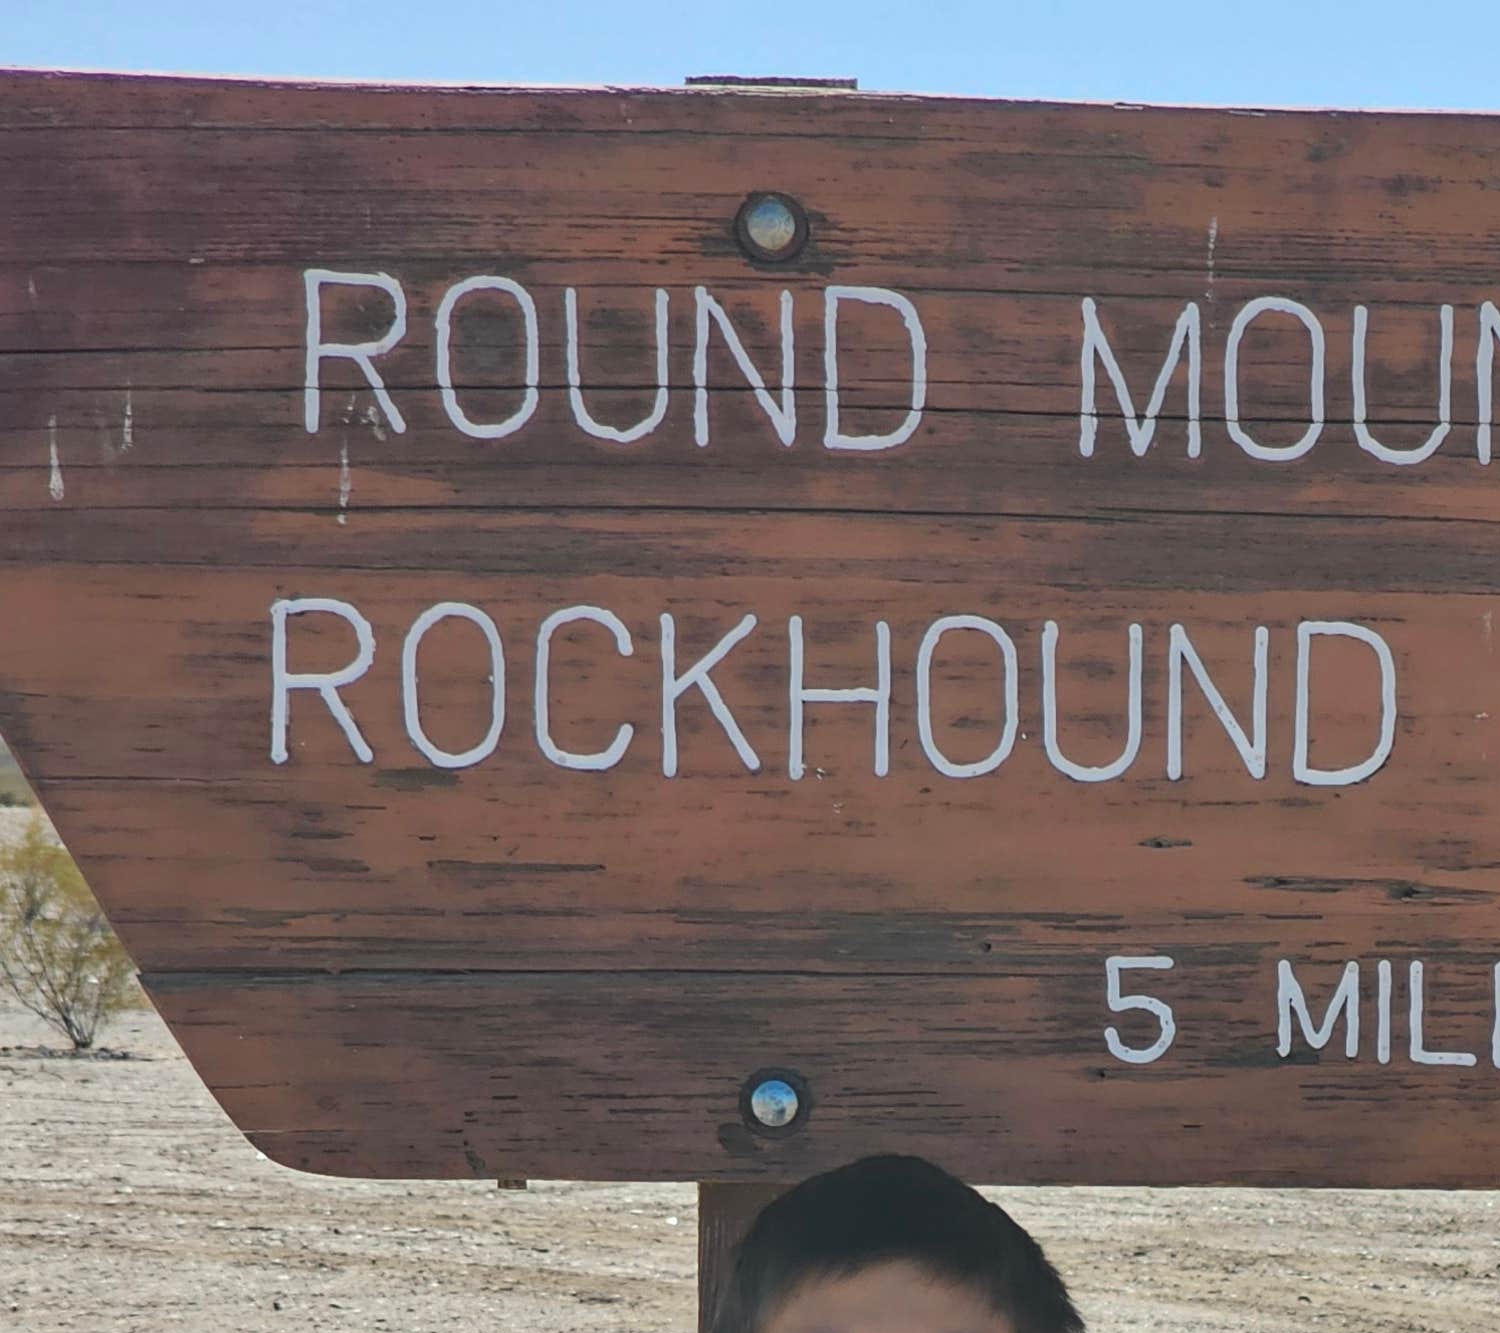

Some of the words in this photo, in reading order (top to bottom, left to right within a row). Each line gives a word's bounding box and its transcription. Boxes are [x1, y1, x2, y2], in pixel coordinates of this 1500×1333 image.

[303, 268, 928, 451] ROUND
[270, 597, 1397, 786] ROCKHOUND
[1104, 955, 1176, 1064] 5
